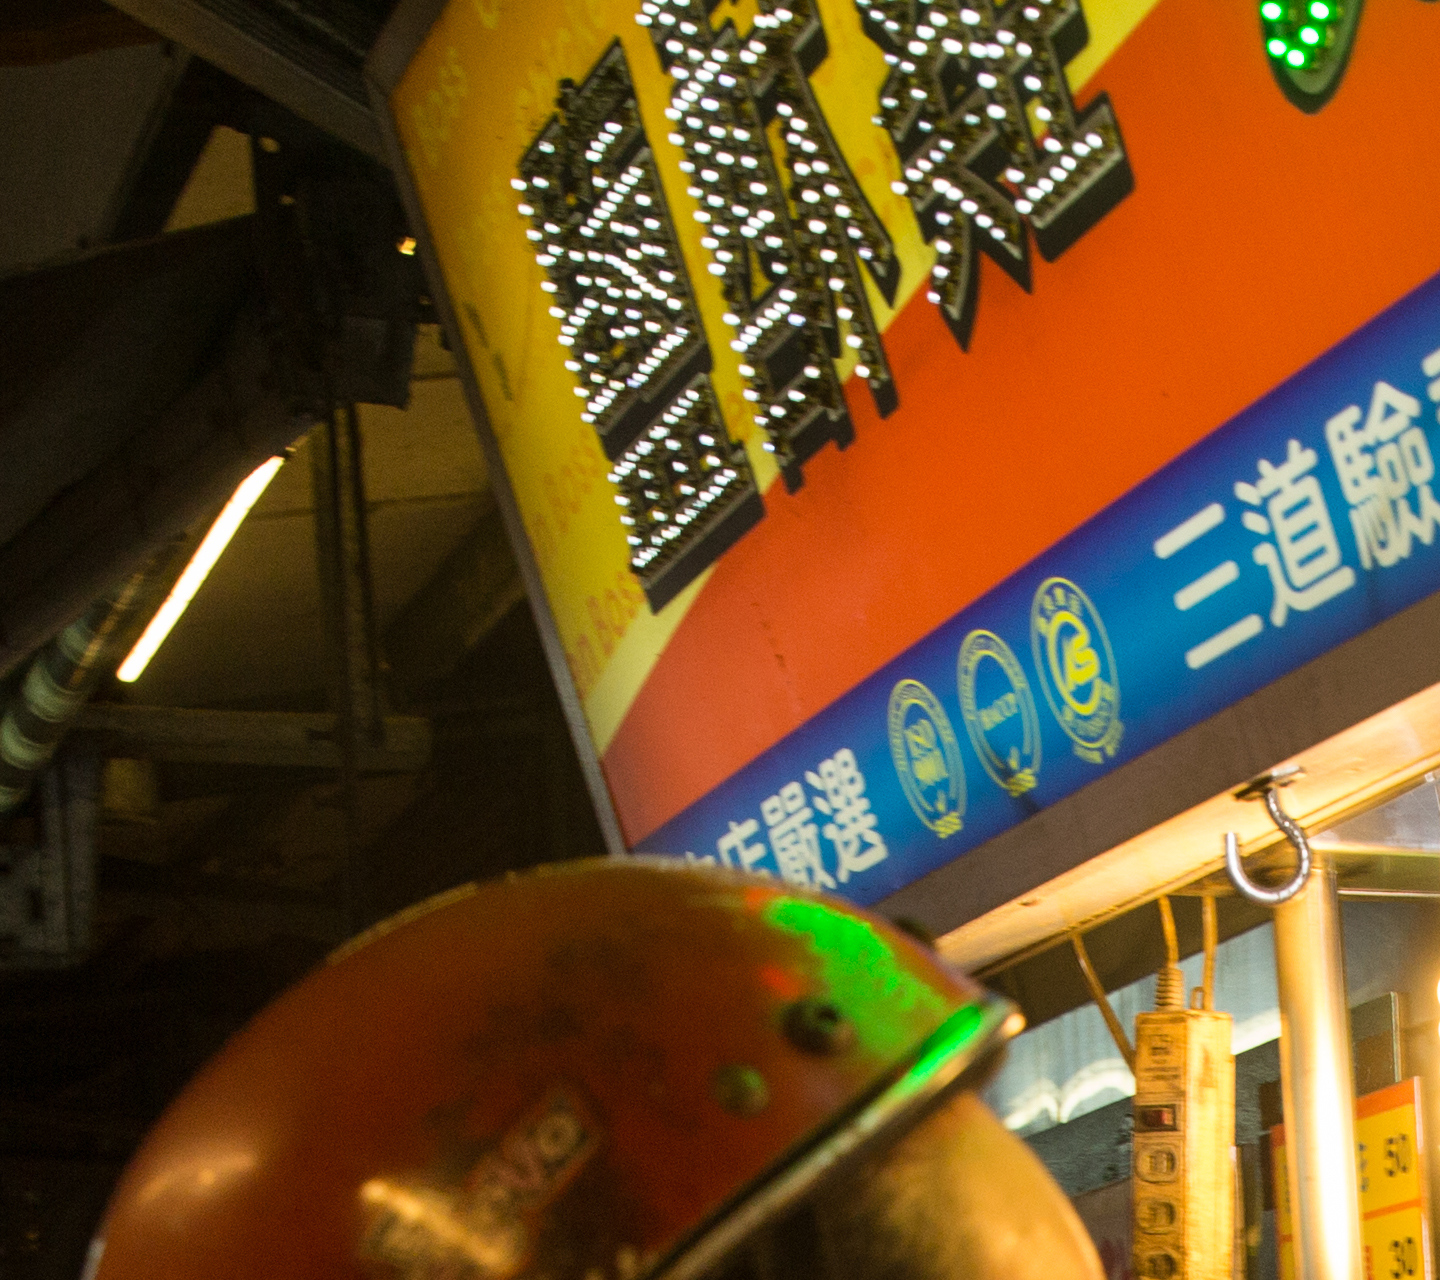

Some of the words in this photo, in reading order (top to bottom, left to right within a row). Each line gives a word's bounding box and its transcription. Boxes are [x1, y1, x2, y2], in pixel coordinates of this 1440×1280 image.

[685, 748, 889, 895] 店嚴選
[1383, 1133, 1412, 1178] 50
[1389, 1236, 1419, 1280] 30
